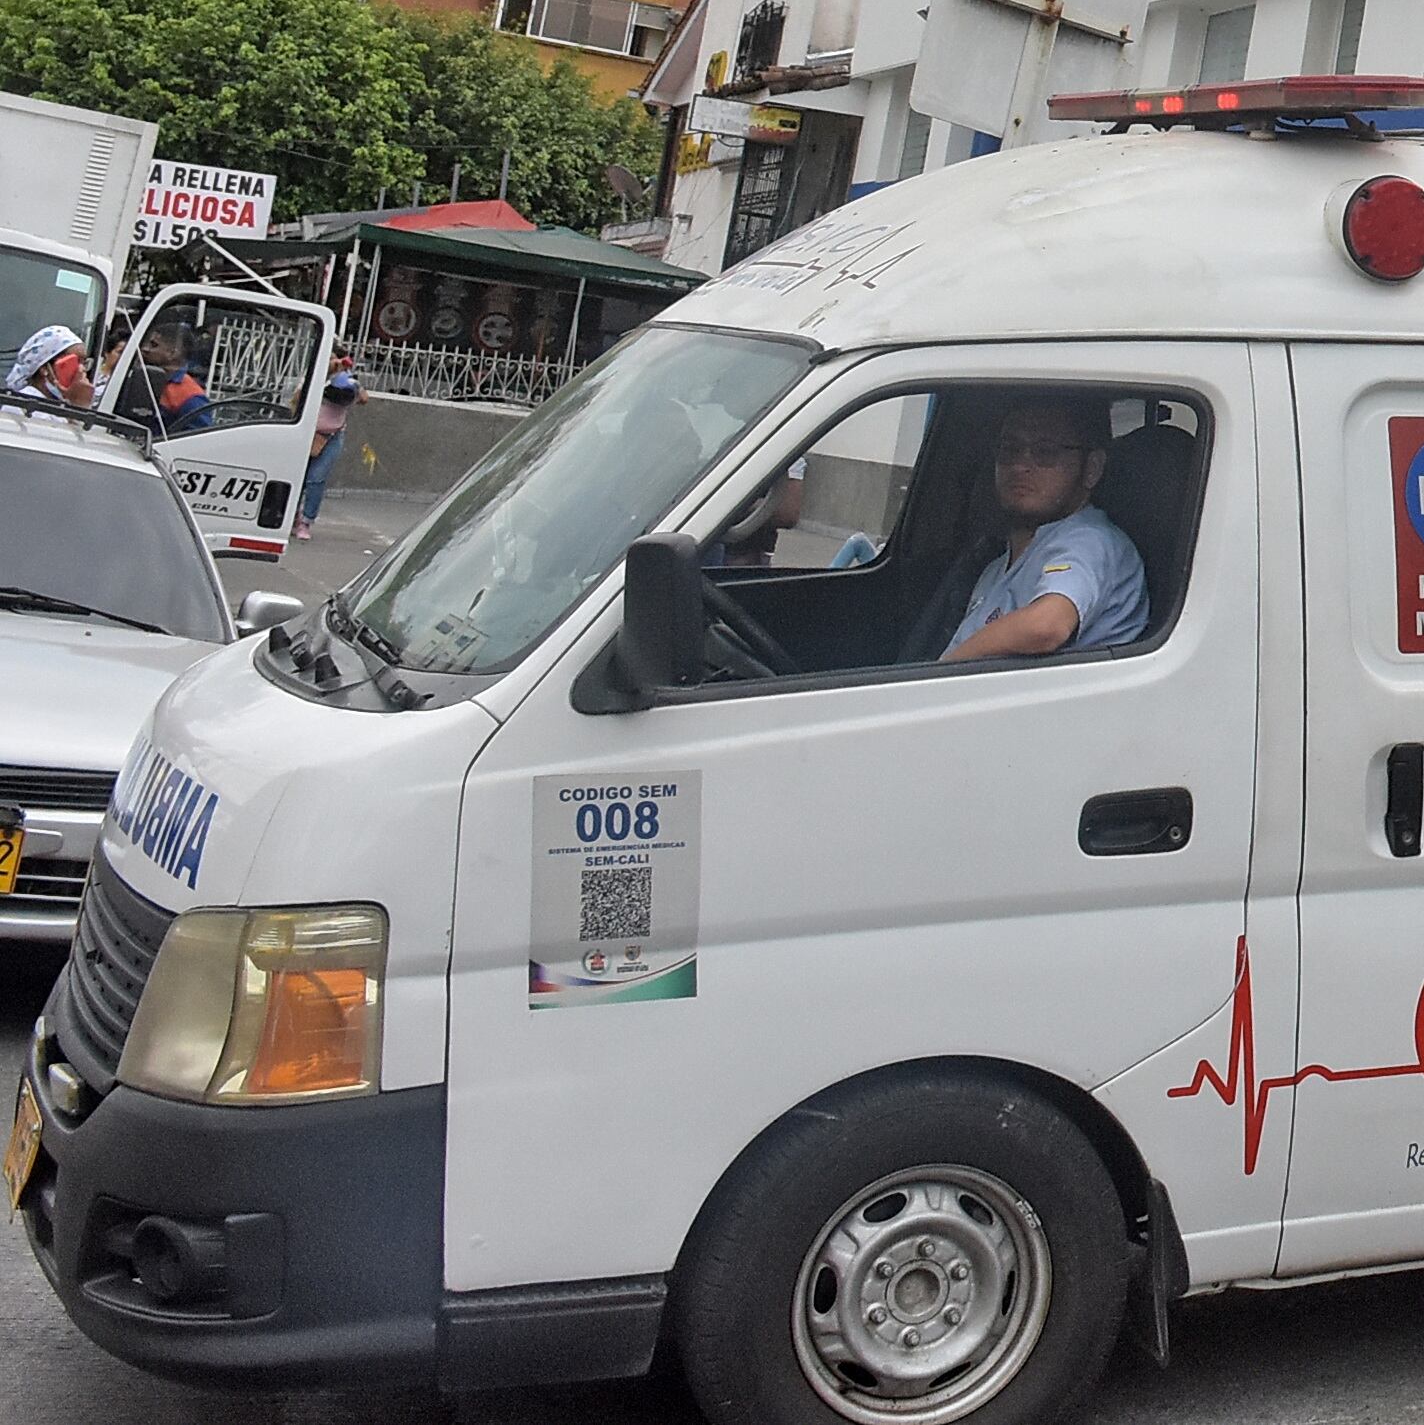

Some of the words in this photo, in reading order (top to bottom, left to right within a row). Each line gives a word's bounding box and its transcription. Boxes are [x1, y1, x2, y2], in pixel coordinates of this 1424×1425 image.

[172, 167, 265, 197] RELLENA
[138, 188, 256, 228] LICIOSA
[559, 785, 633, 802] CODIGO
[638, 783, 677, 798] SEM
[576, 800, 660, 843] 008
[548, 846, 581, 855] SISTEMA
[585, 853, 650, 867] SEM-CALI
